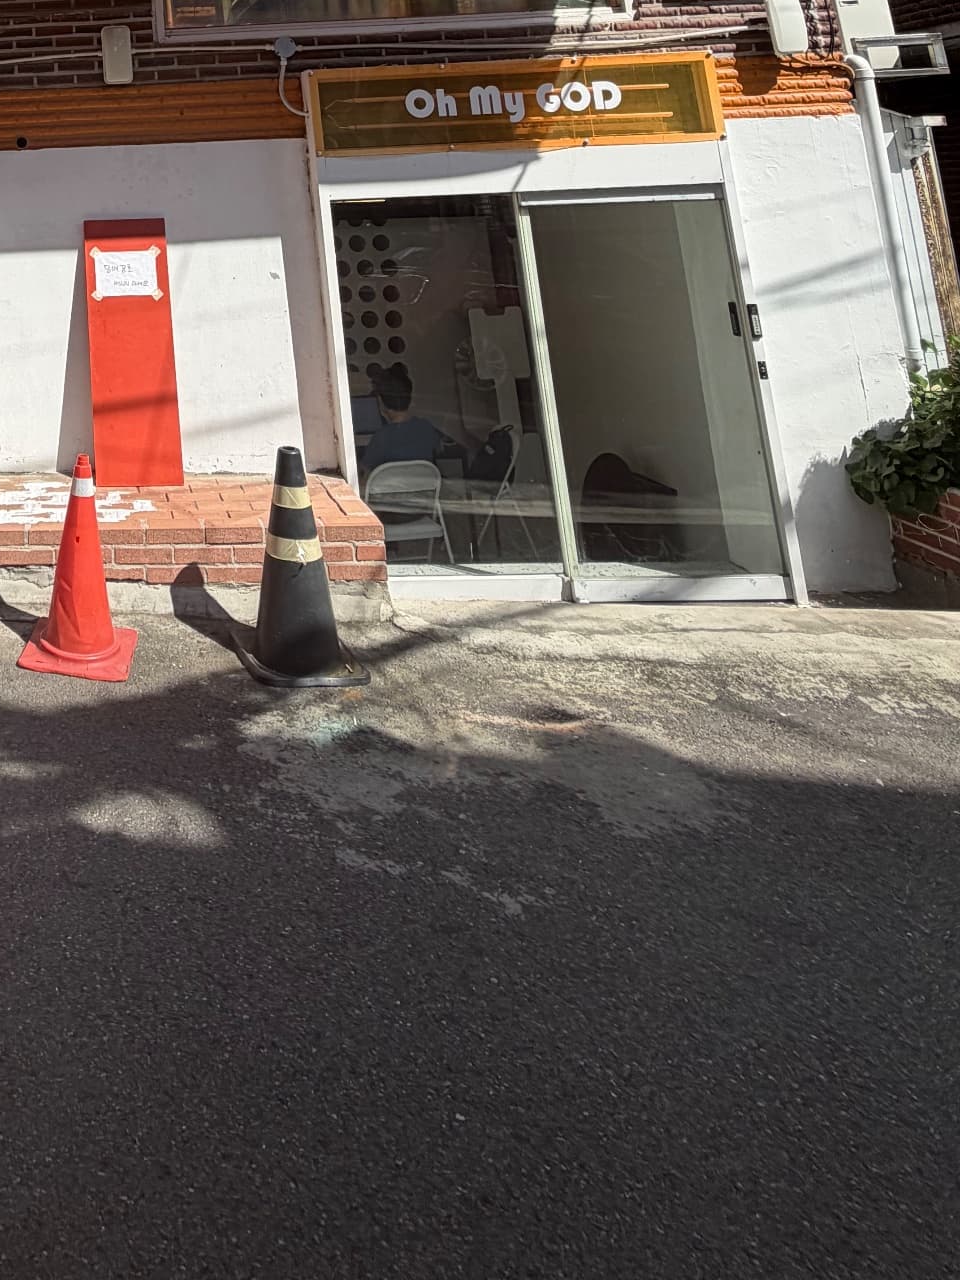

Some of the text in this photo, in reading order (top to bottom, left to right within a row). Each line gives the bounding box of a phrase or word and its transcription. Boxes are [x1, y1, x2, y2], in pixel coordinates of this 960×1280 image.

[405, 80, 622, 123] Oh My GOD
